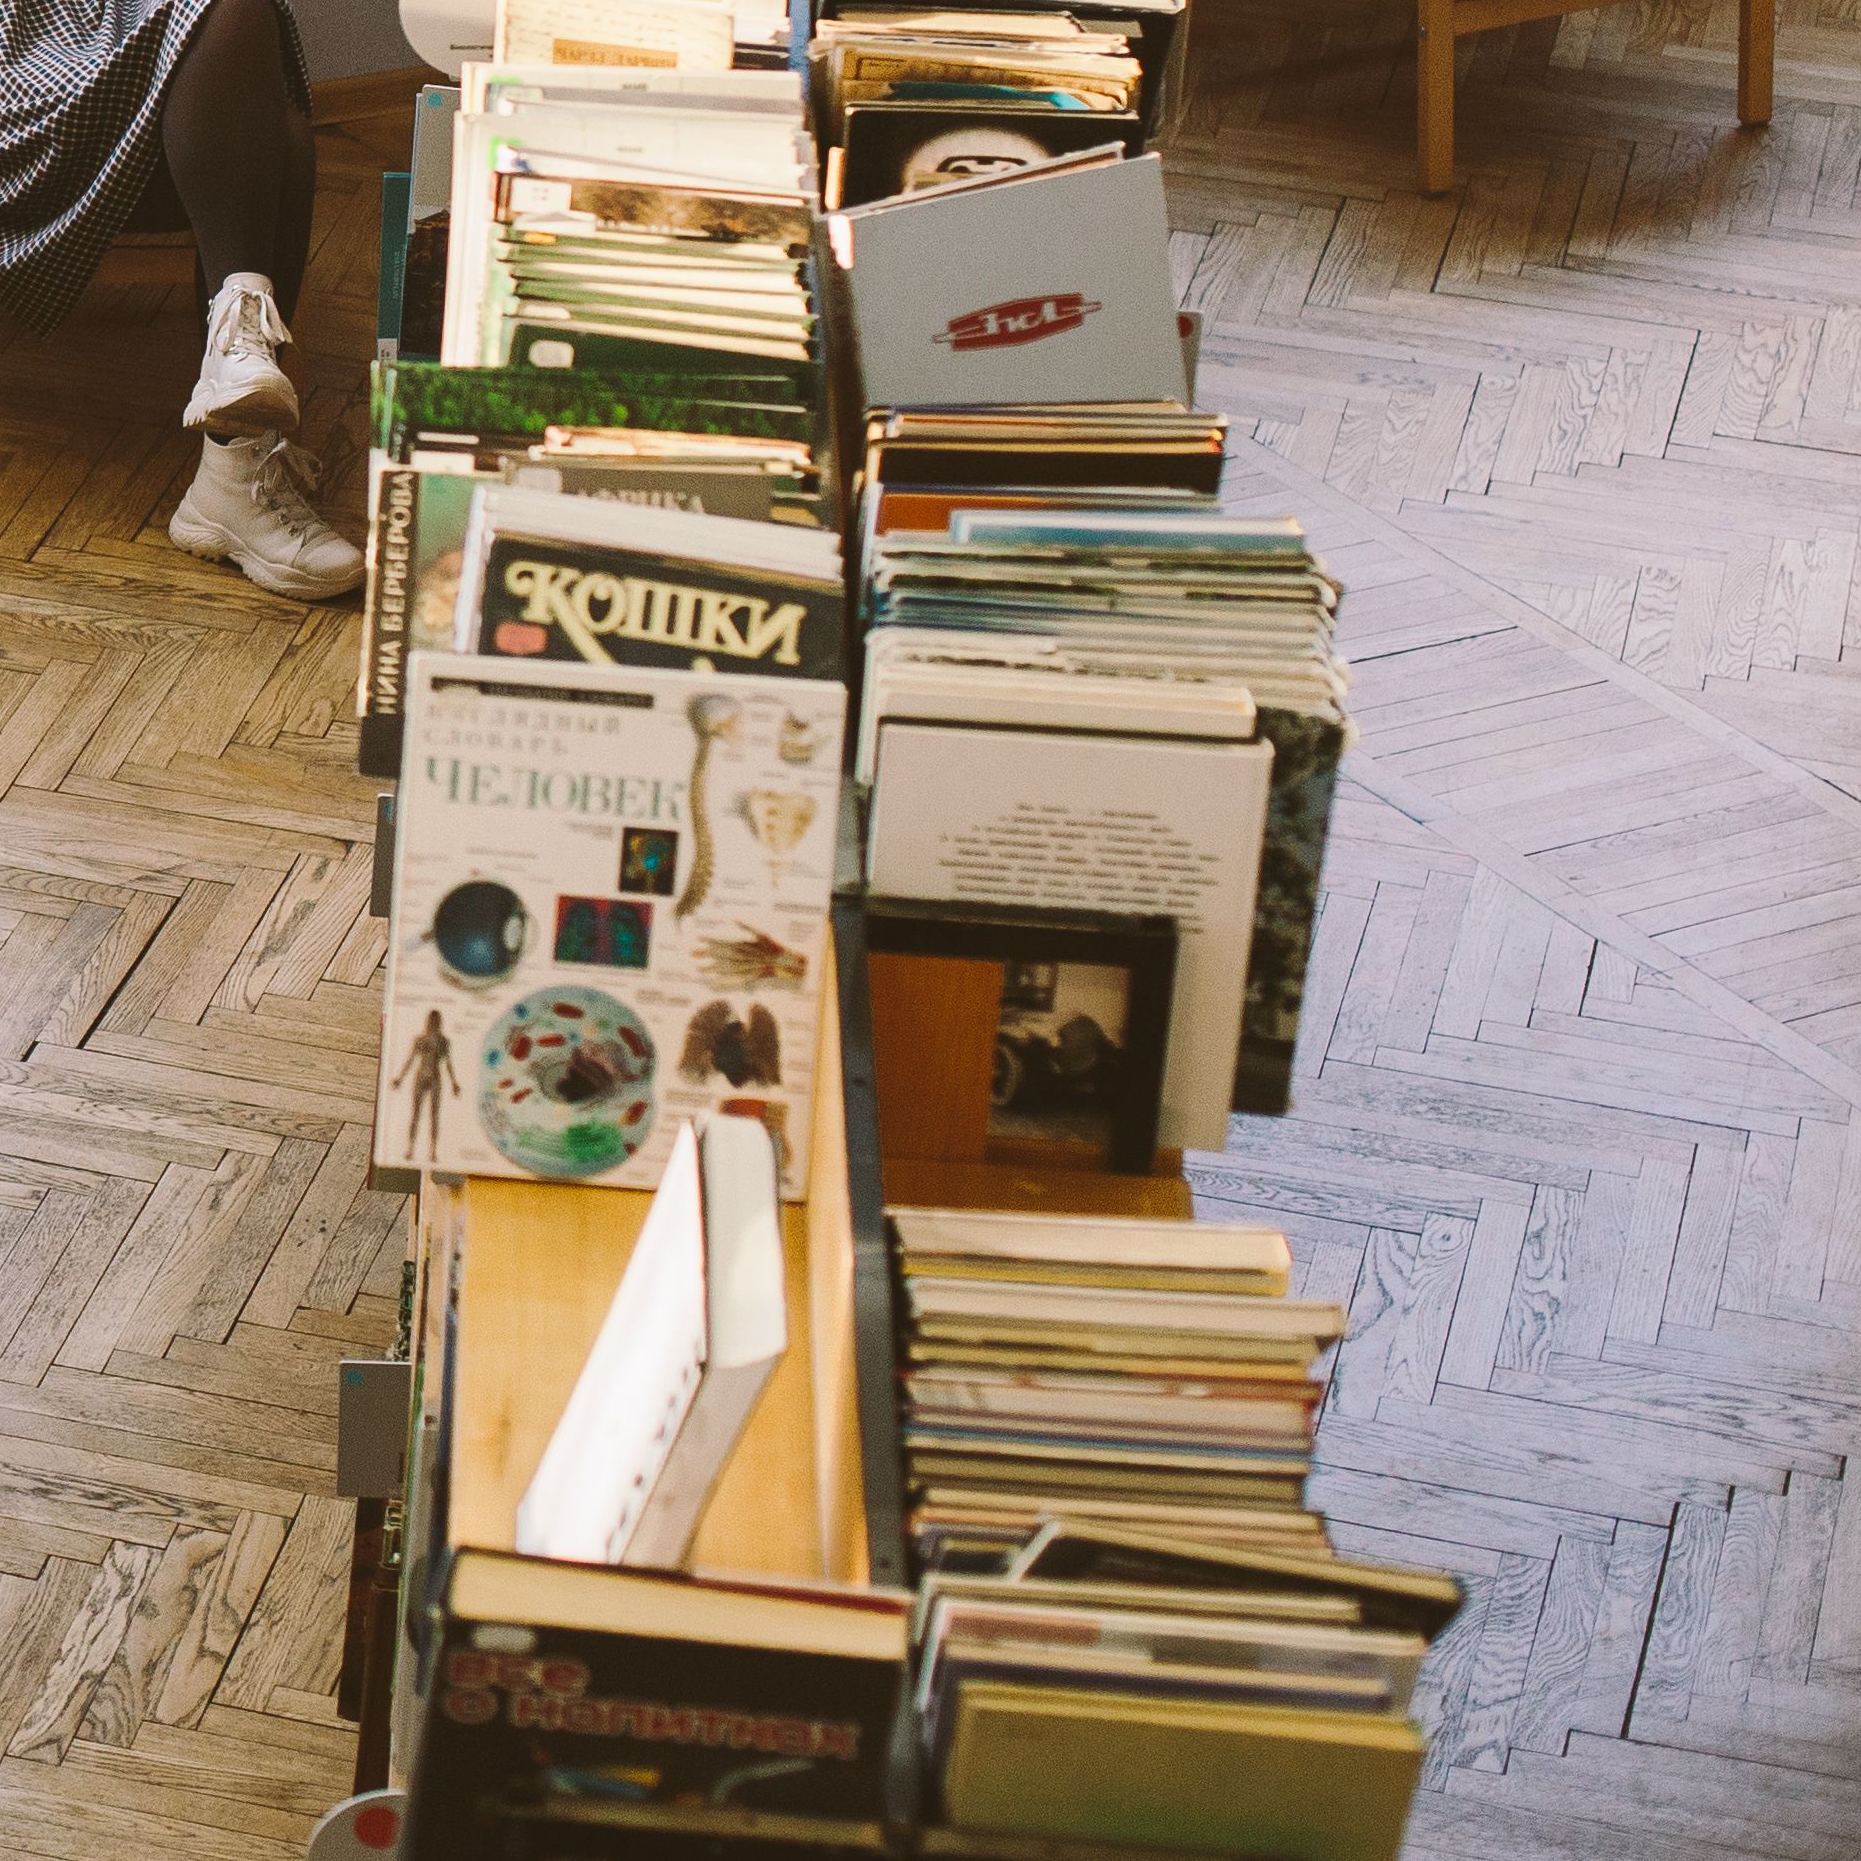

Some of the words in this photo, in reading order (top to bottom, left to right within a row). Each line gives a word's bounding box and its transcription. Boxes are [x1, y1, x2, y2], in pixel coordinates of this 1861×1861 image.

[504, 559, 808, 667] КОШКИ
[376, 638, 402, 715] НИНА
[425, 756, 688, 820] ЧЕЛОВЕК
